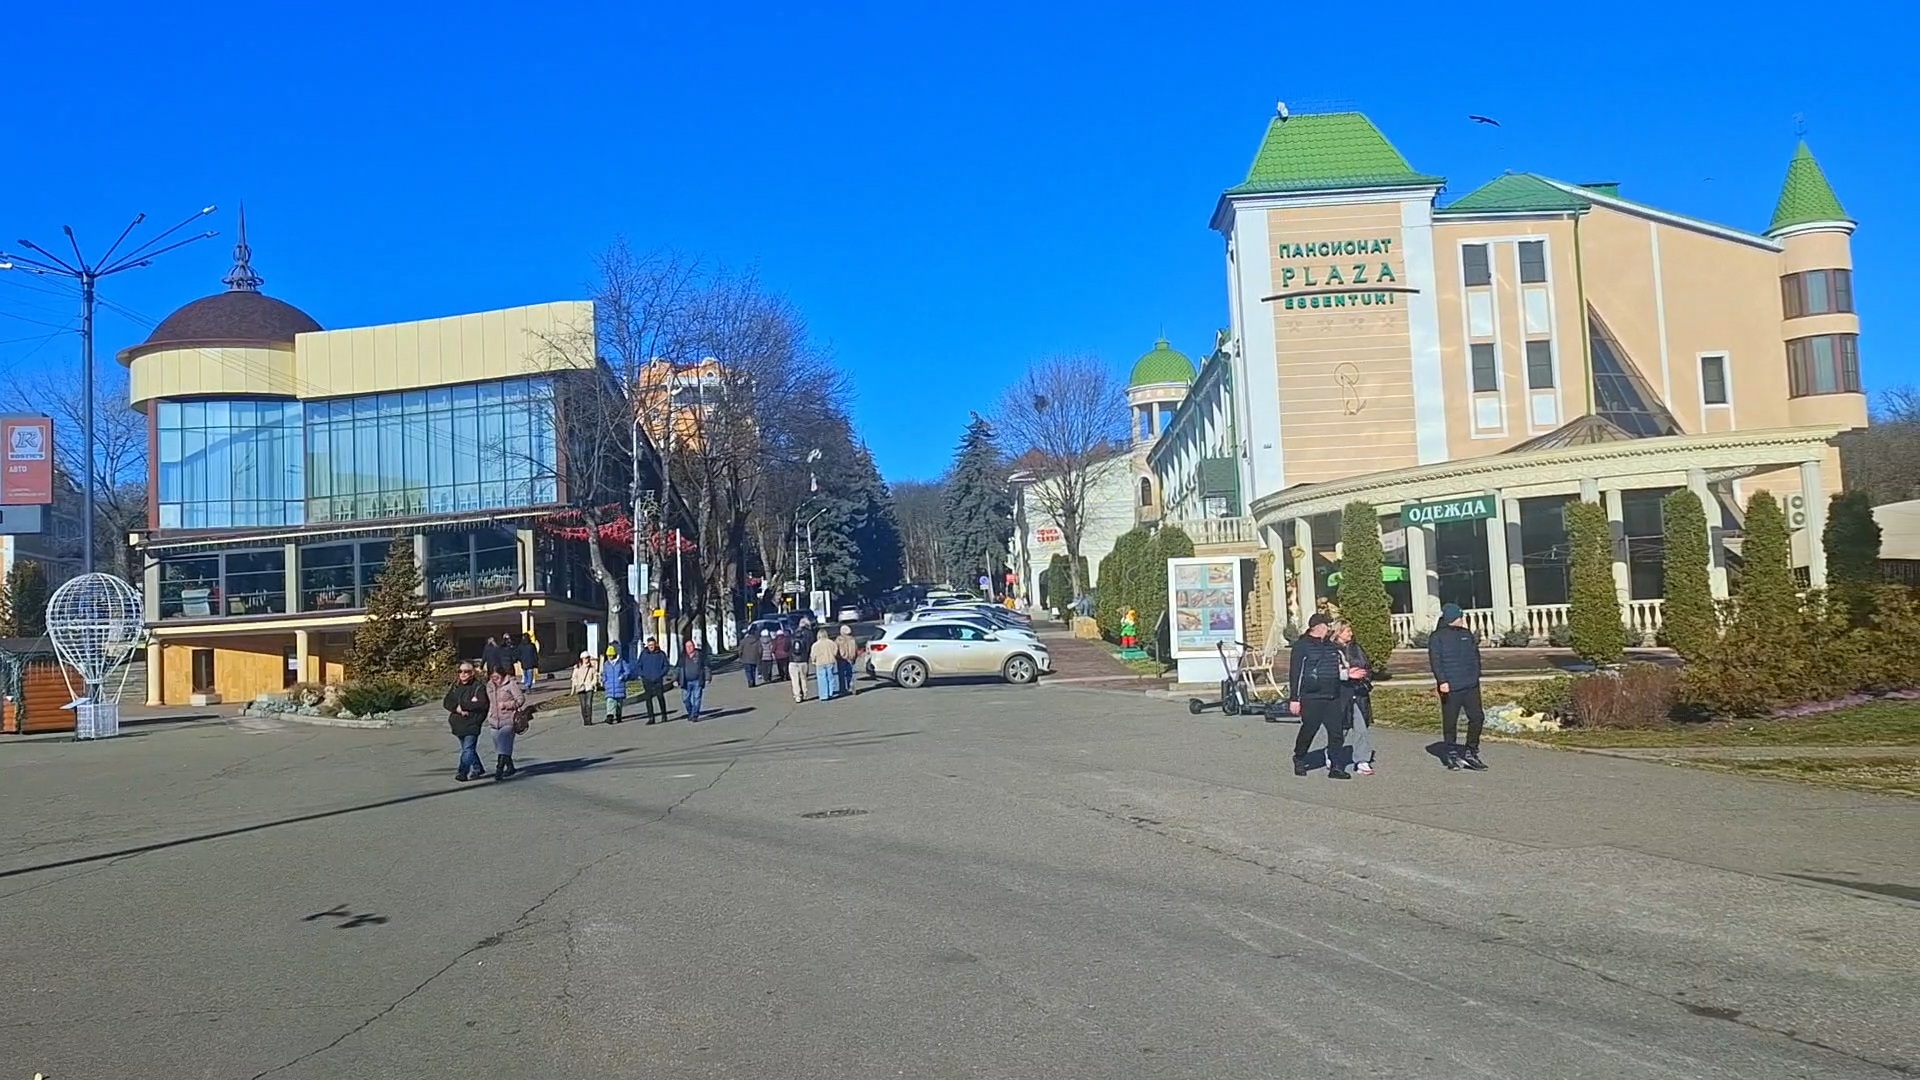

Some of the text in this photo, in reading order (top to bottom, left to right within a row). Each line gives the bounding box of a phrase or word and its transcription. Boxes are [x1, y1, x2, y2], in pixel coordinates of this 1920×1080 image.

[1279, 238, 1391, 258] ПАНСИОНАТ
[1281, 262, 1395, 287] PLAZA
[1285, 293, 1394, 309] ESSENTUKI
[1409, 500, 1487, 522] ОДЕЖДА
